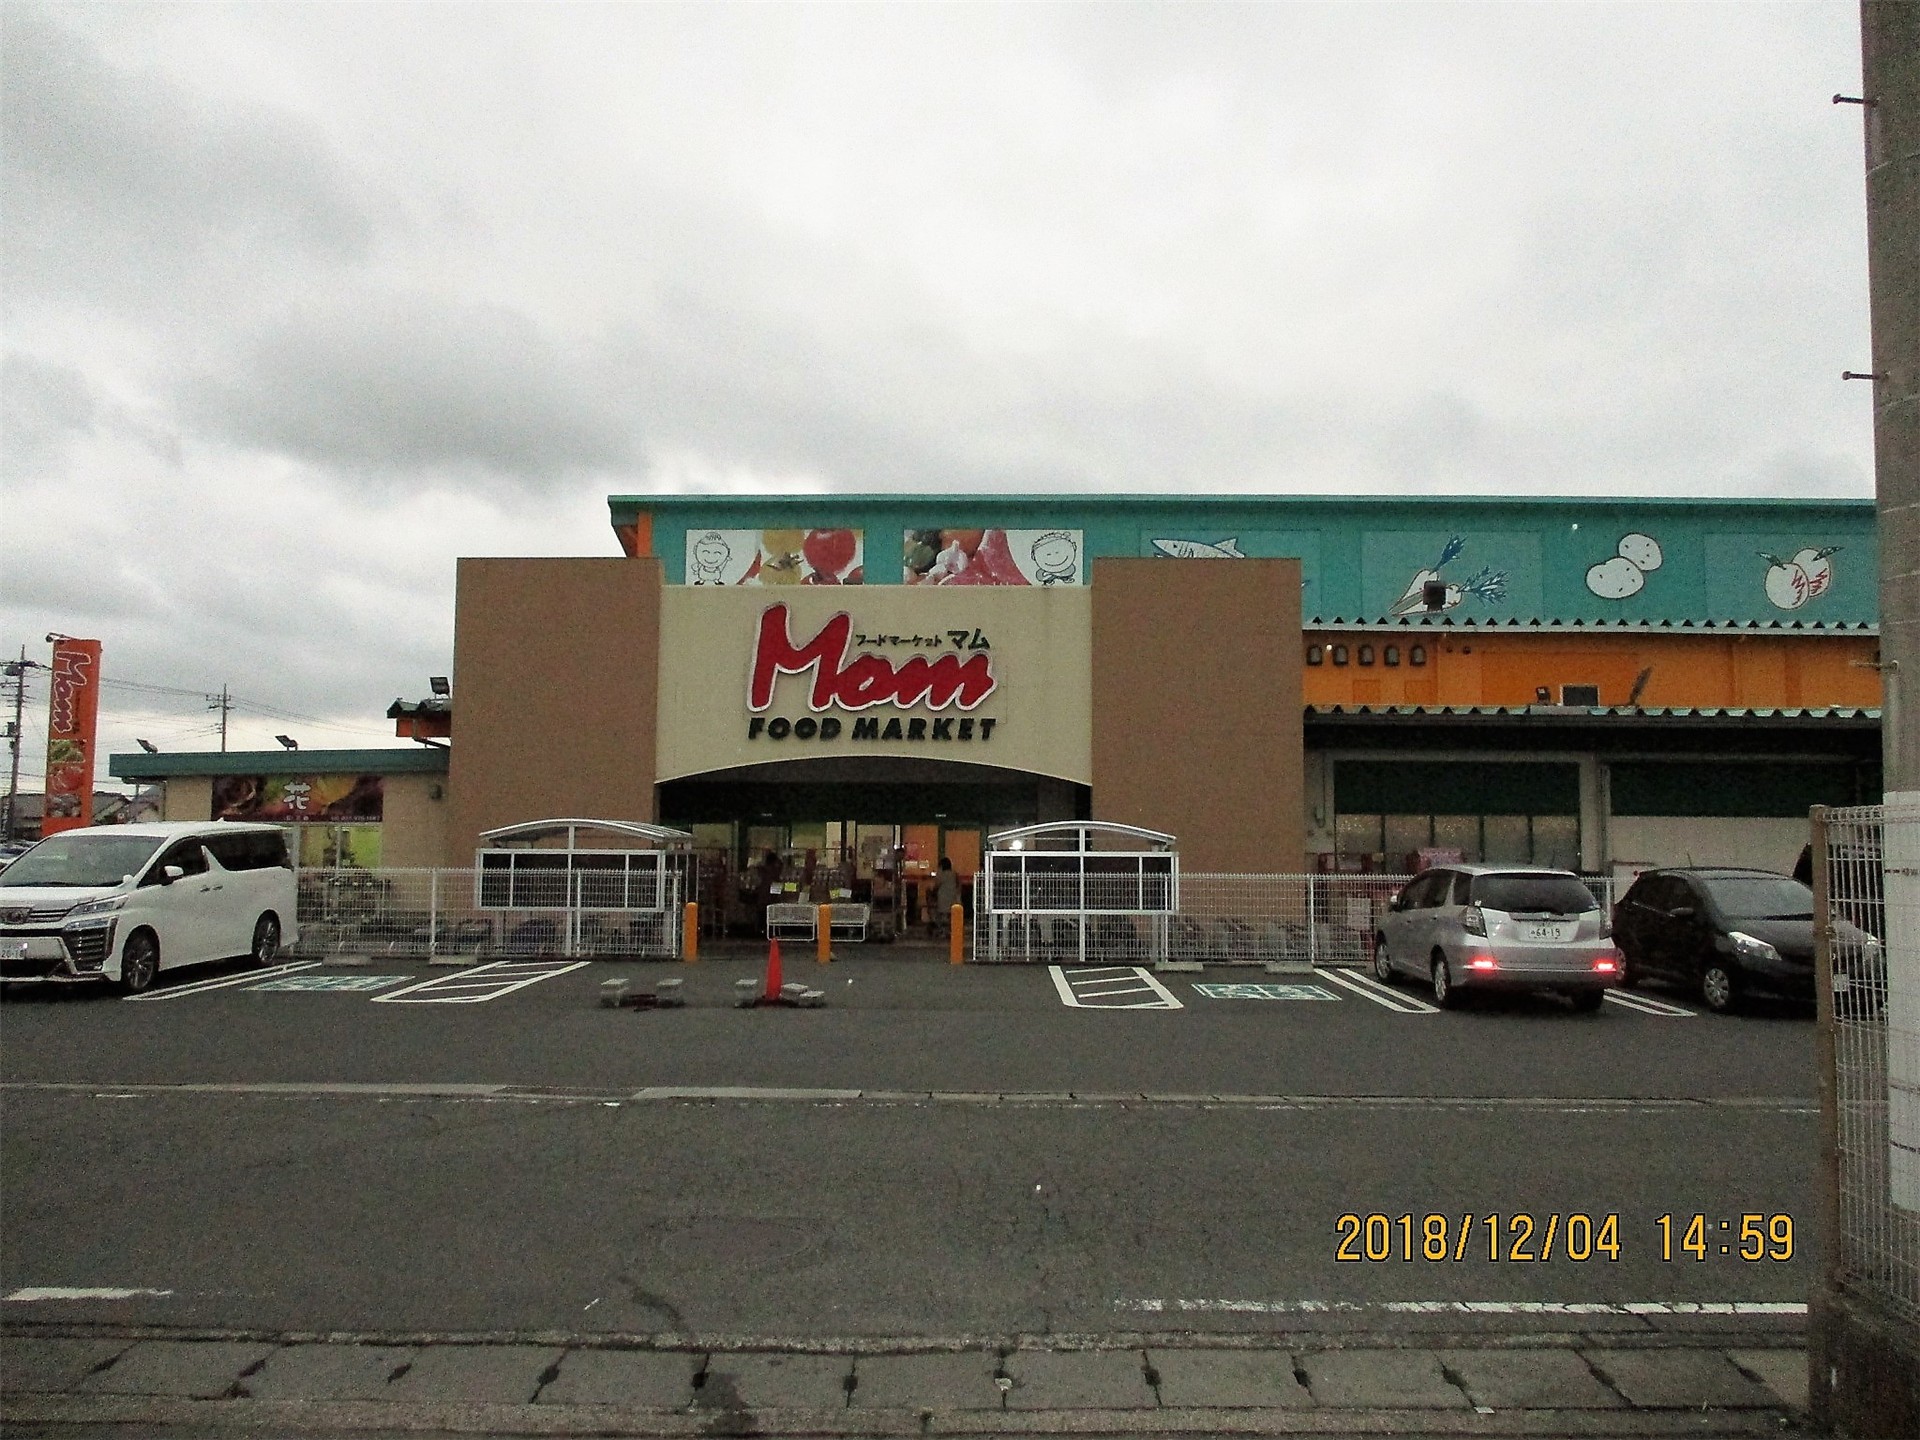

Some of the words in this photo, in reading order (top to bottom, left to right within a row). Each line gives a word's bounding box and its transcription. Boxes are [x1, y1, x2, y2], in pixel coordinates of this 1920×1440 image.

[855, 633, 943, 647] フードマーケット
[947, 628, 991, 650] マム
[747, 602, 998, 713] Mom
[52, 650, 91, 734] Mom
[748, 717, 842, 740] FOOD
[851, 717, 997, 741] MARKET
[283, 780, 312, 810] 花
